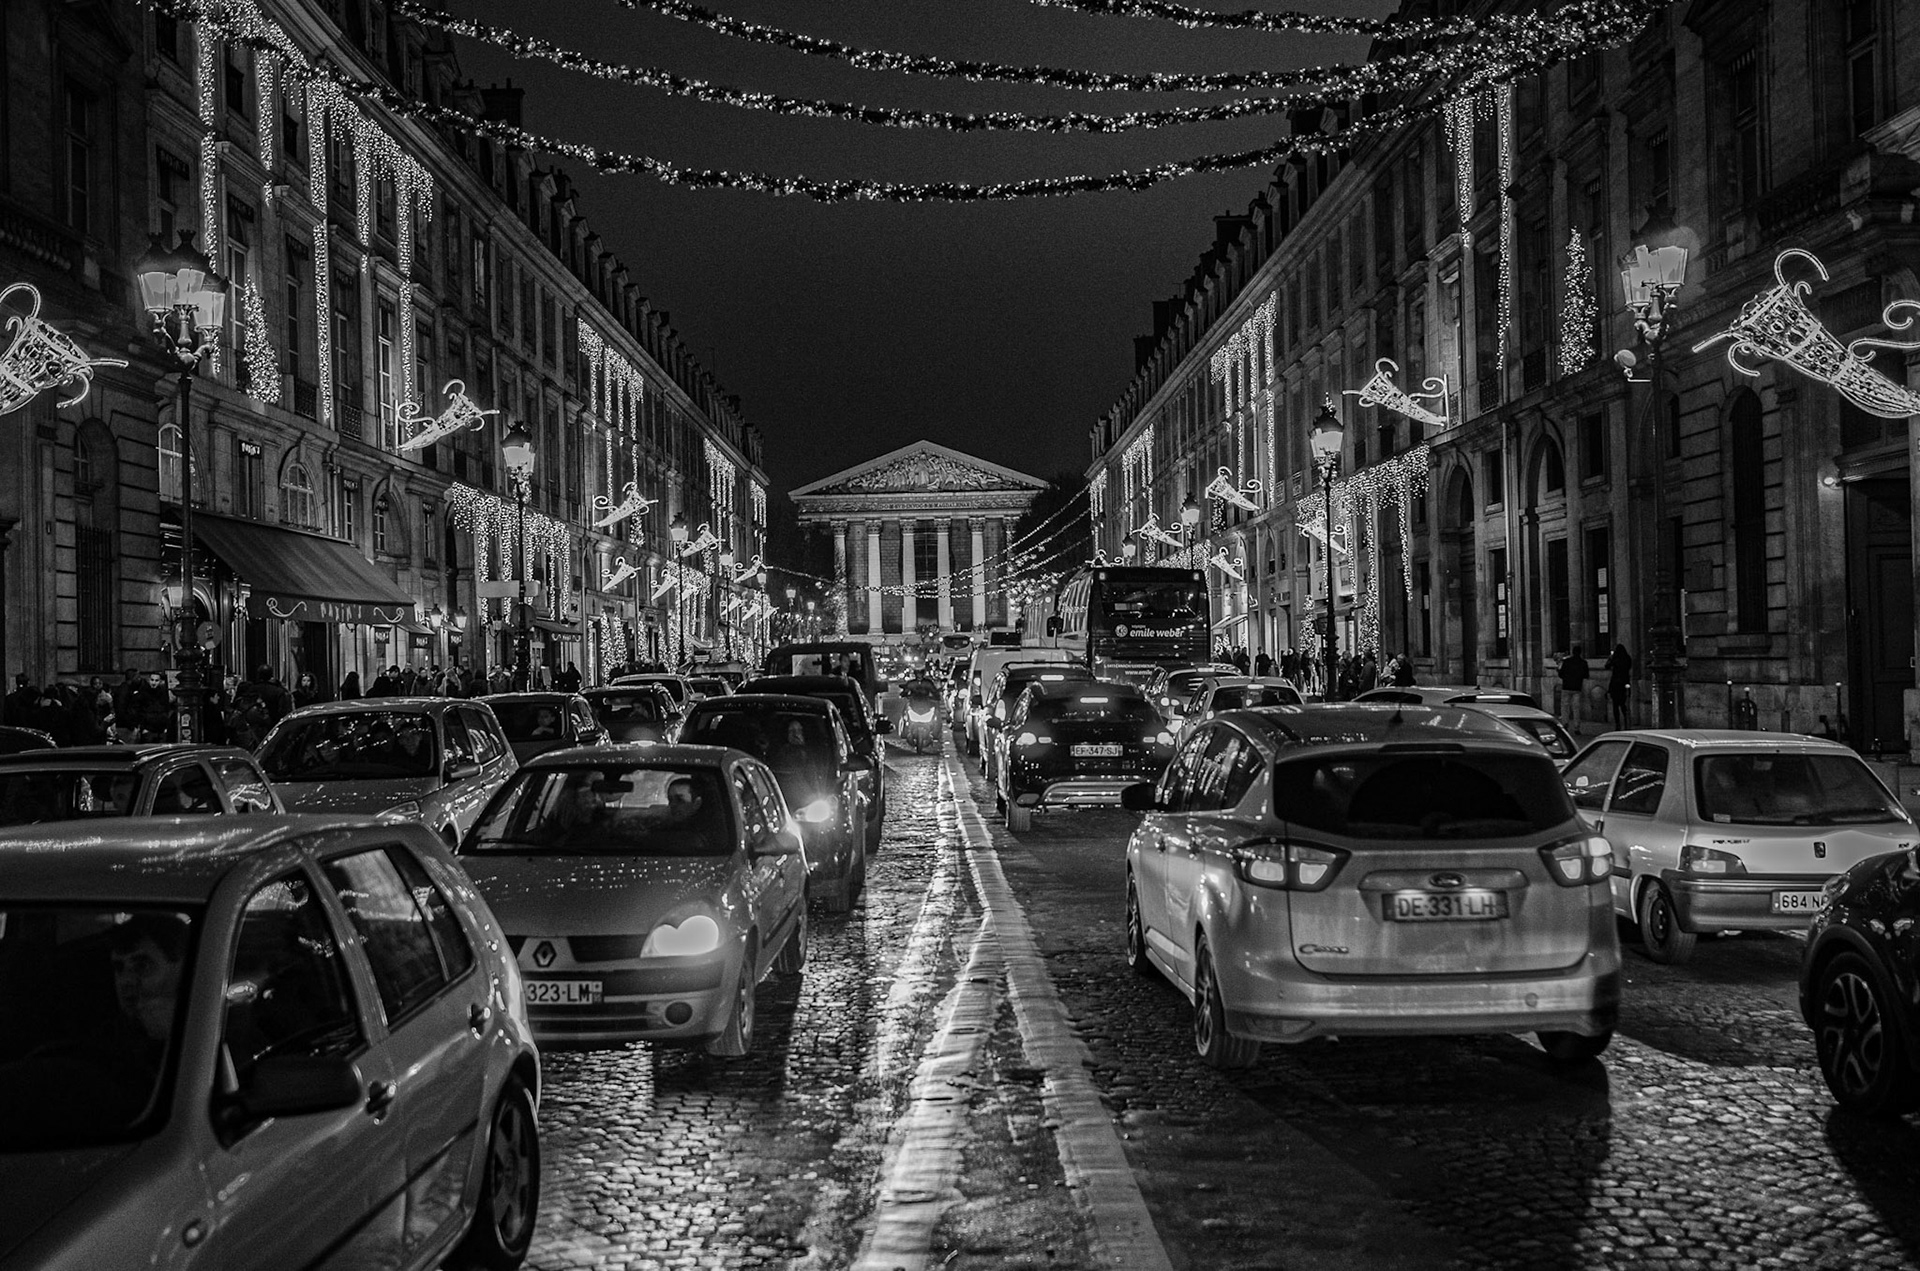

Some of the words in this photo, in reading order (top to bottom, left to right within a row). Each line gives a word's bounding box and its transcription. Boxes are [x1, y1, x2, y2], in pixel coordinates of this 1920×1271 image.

[1129, 628, 1155, 637] emile
[1156, 628, 1184, 637] weber
[1782, 894, 1807, 908] 684
